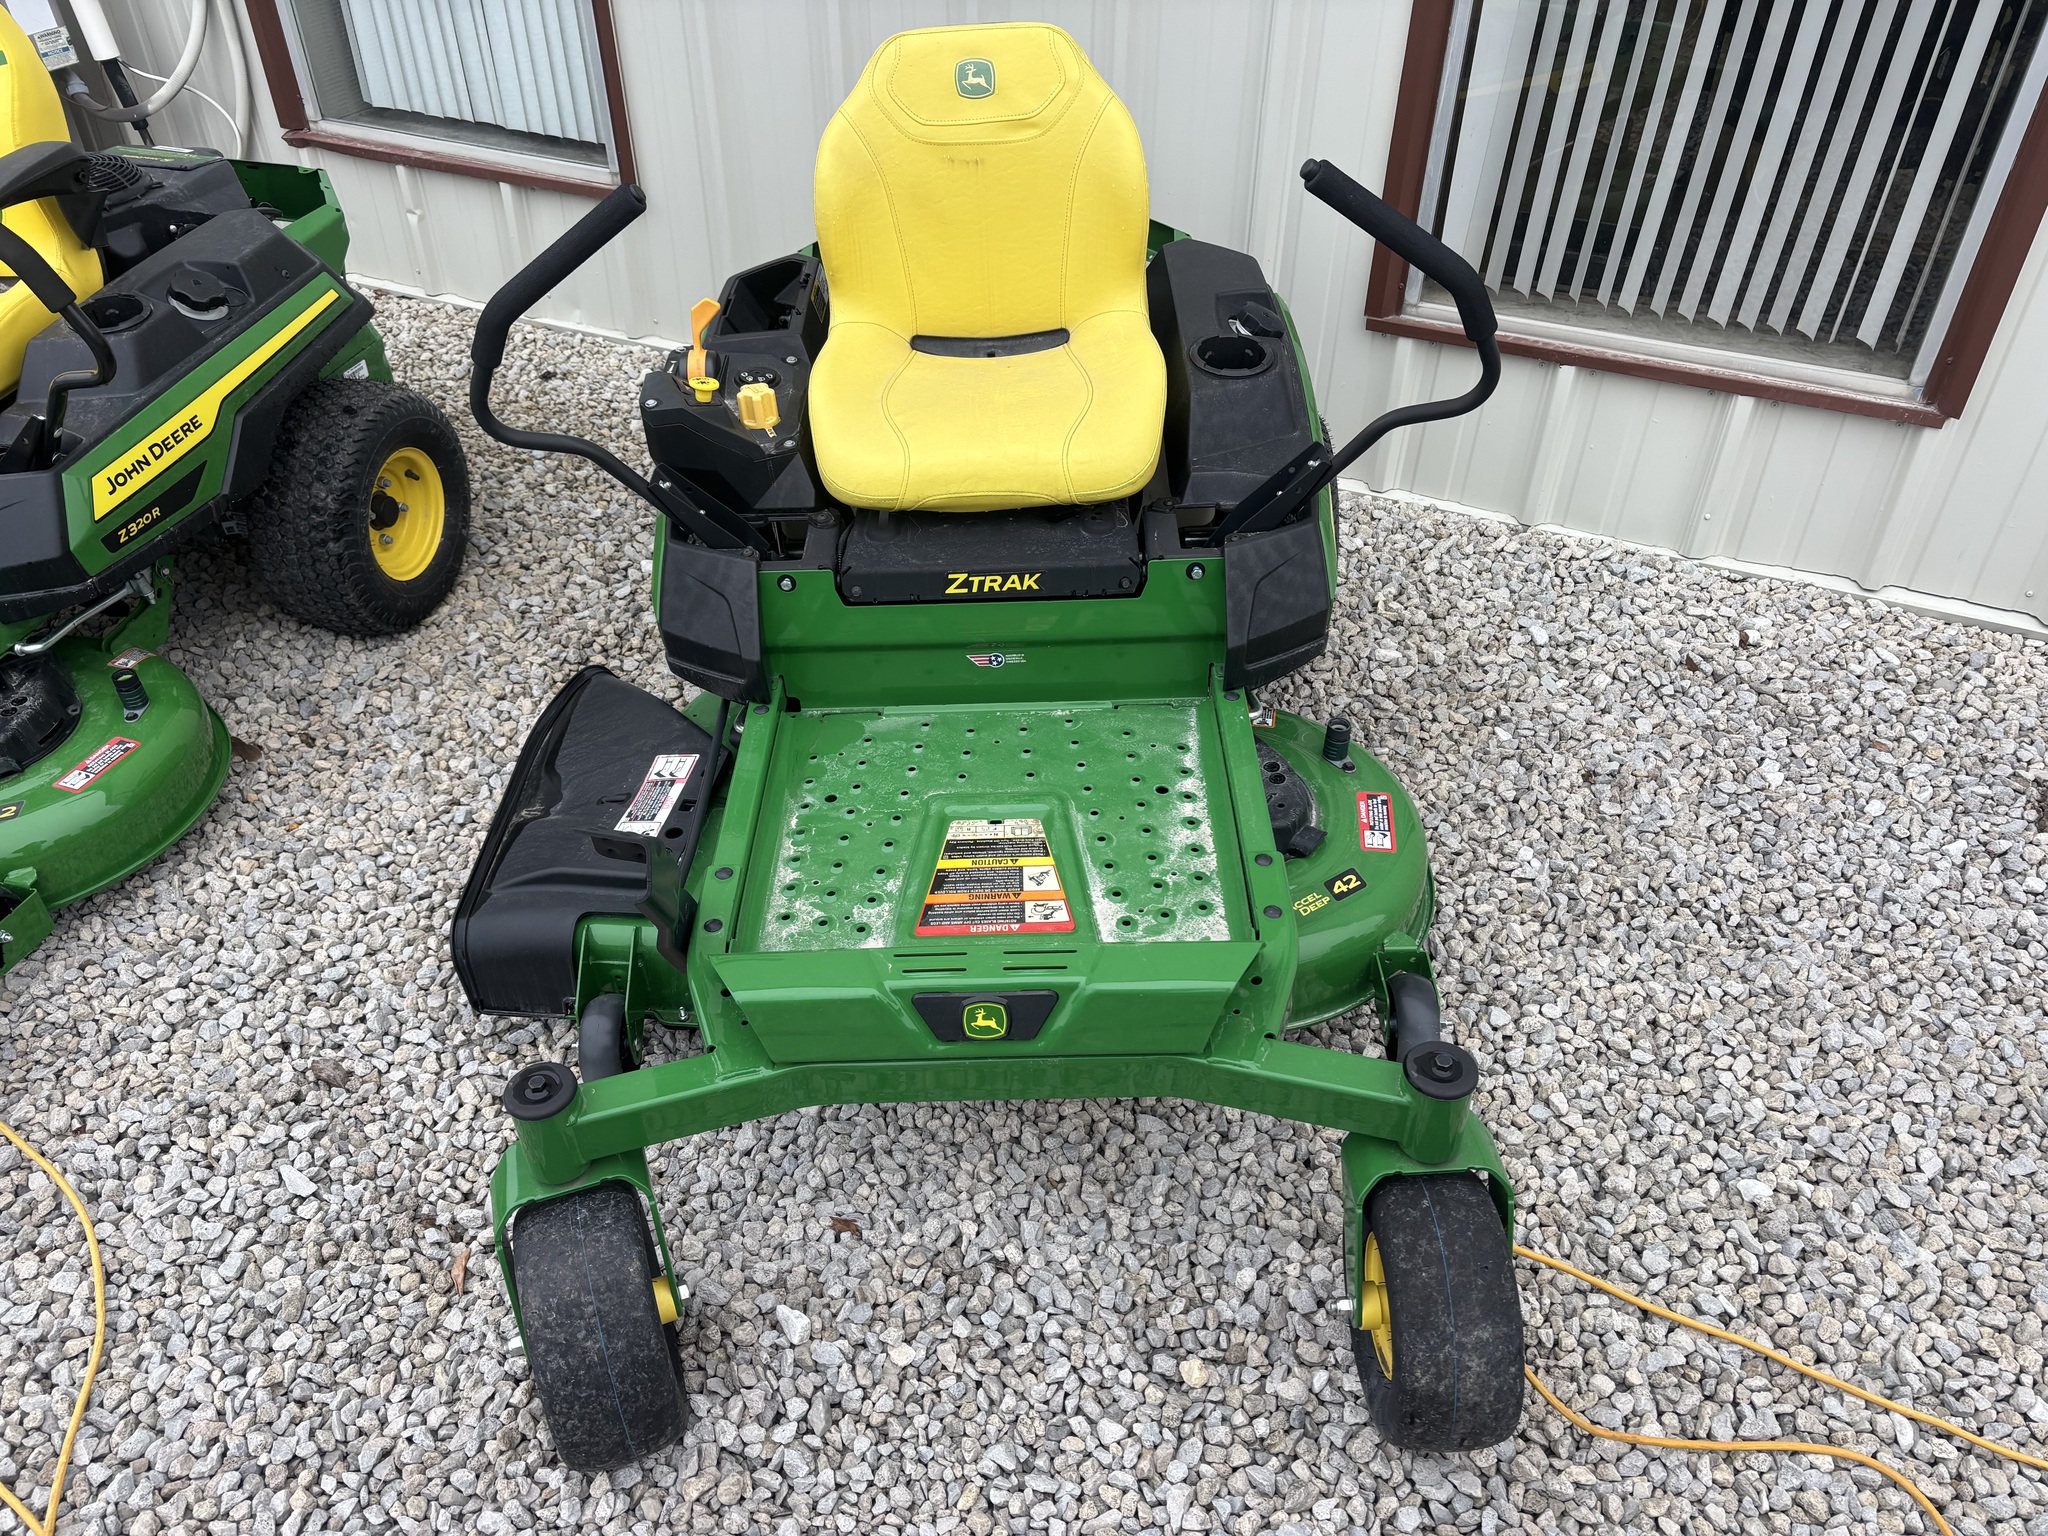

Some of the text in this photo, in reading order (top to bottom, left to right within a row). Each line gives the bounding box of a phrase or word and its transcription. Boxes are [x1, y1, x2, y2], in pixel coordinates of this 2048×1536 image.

[106, 414, 203, 496] JOHN DEERE
[118, 506, 161, 544] Z320R
[945, 573, 1042, 594] ZTRAK
[971, 858, 1008, 866] CAUTION
[1333, 874, 1361, 895] 42
[968, 892, 1011, 900] WARNING
[1299, 896, 1330, 917] DEEP
[970, 924, 1009, 933] DANGER
